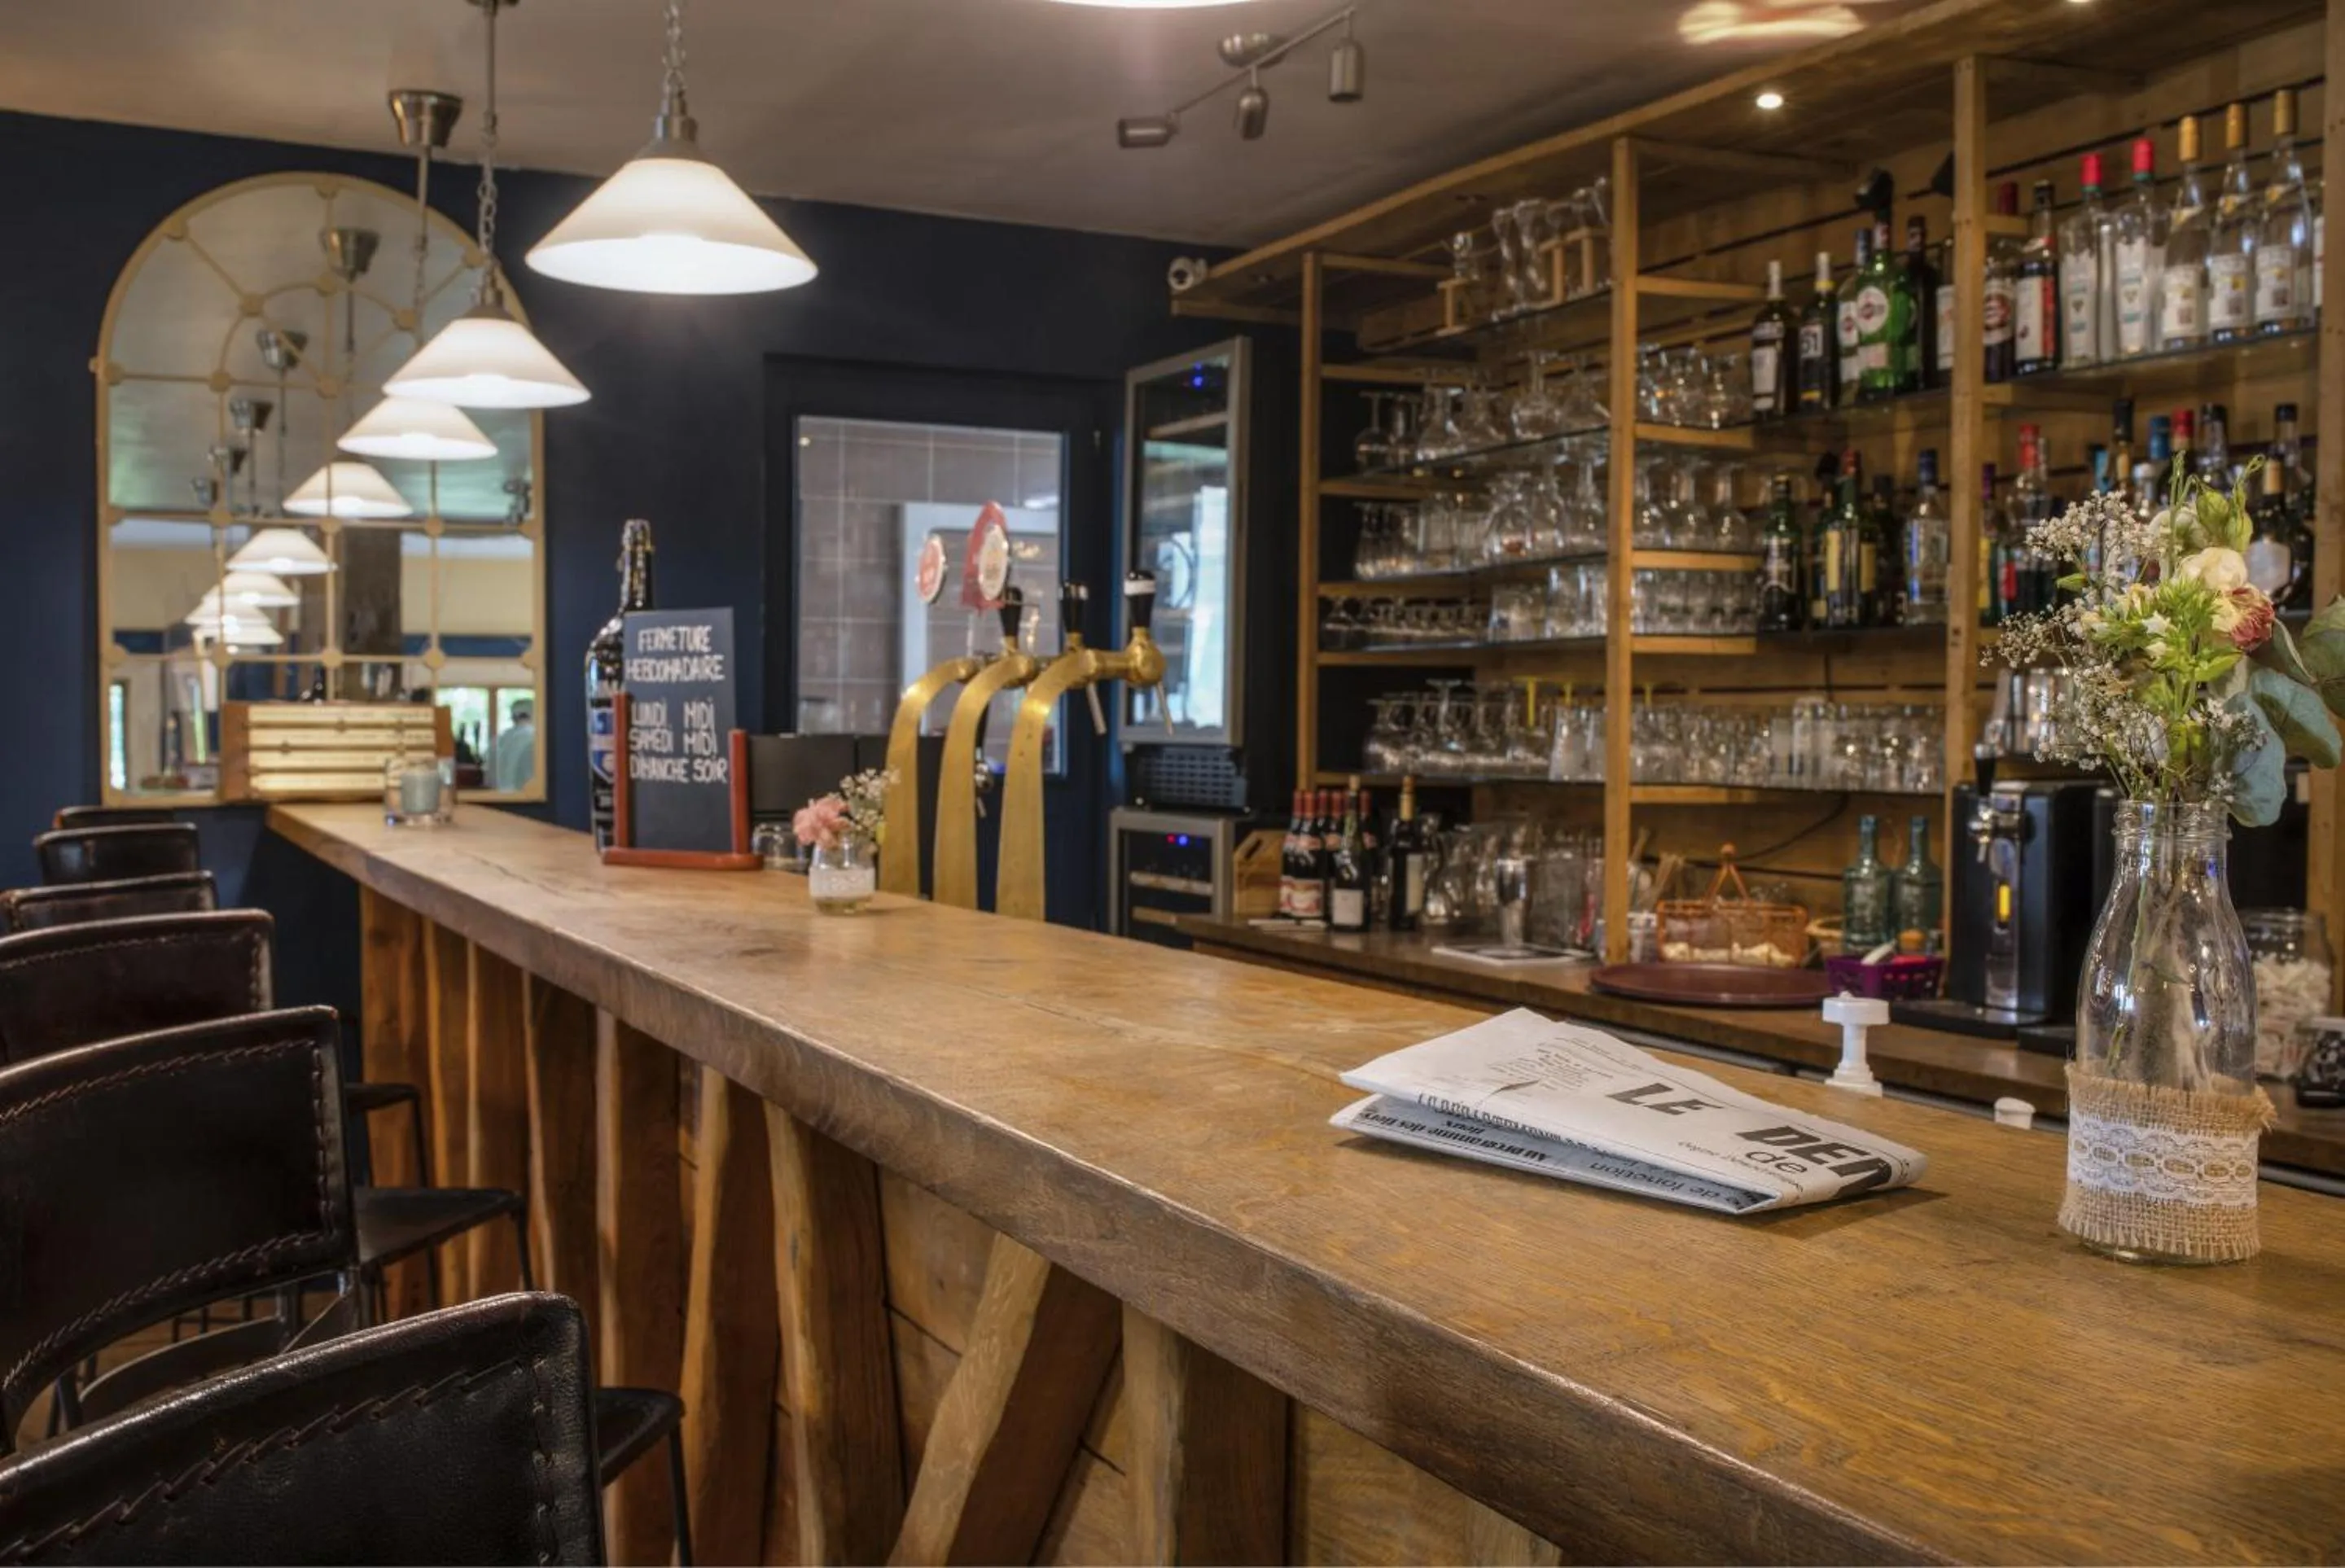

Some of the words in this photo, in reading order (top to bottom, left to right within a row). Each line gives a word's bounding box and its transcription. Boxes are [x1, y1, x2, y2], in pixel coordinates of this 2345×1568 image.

[638, 625, 712, 653] FERMETURE
[626, 655, 725, 682] HEBDOMADAIRE
[629, 754, 690, 782] DIMANCHE
[1606, 1082, 1725, 1116] LE
[1745, 1150, 1808, 1175] de
